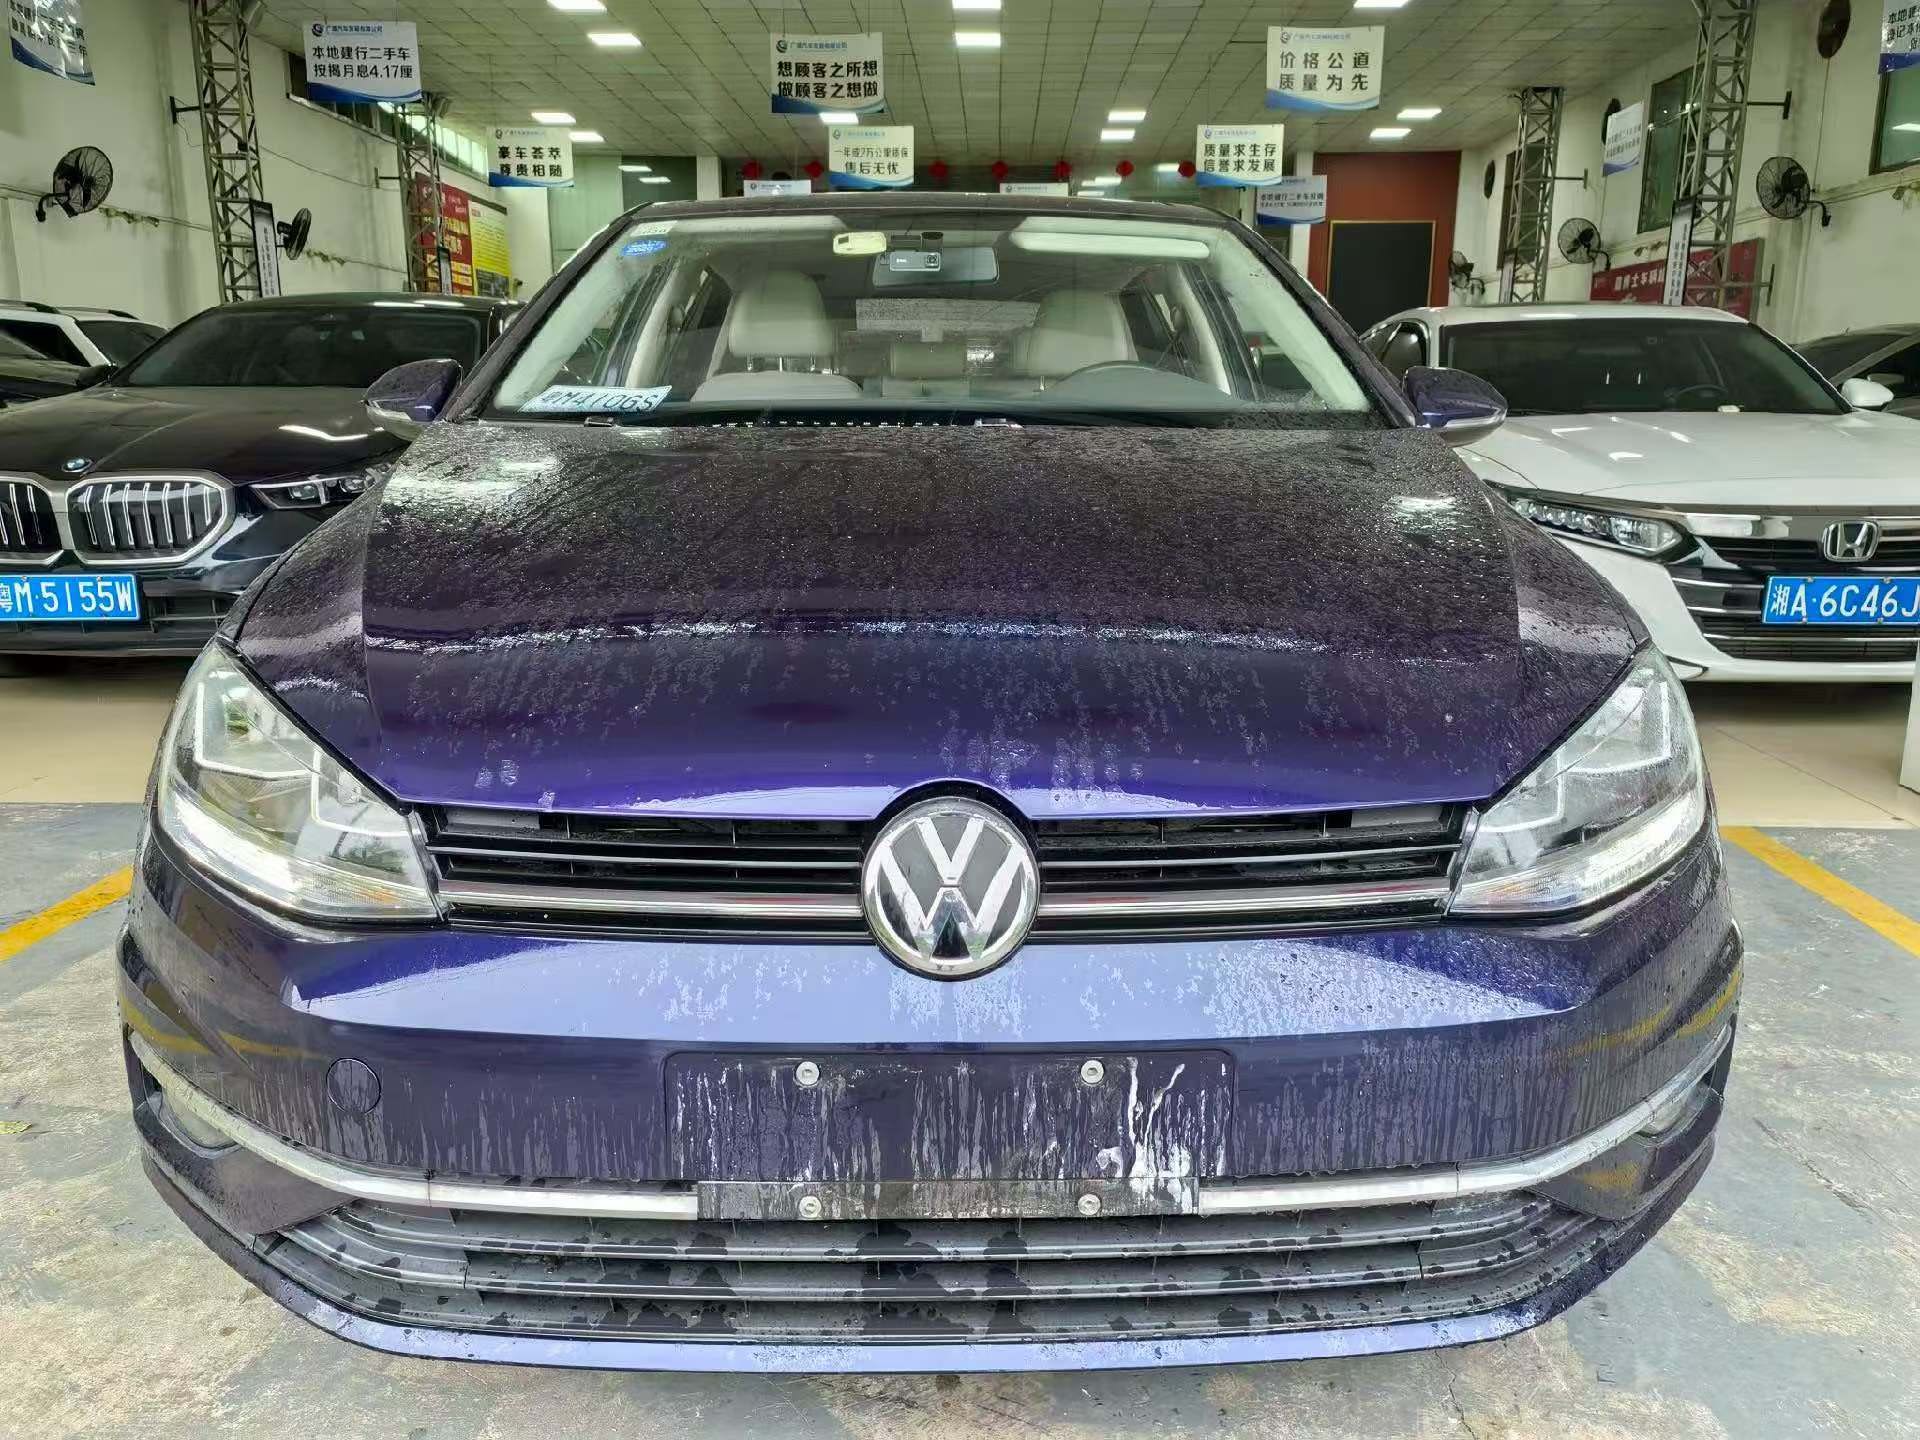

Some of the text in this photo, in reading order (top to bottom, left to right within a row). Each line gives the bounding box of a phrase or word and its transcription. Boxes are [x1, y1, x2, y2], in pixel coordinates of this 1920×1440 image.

[312, 45, 411, 61] 本地建行二手车
[1280, 51, 1370, 69] 价格公道
[314, 63, 413, 78] 按揭月息4.17厘
[777, 60, 878, 78] 想顾客之所想
[777, 81, 879, 98] 做顾客之想做
[1279, 73, 1369, 91] 质量为先
[498, 146, 561, 160] 豪车荟萃
[1204, 143, 1277, 157] 质量求生存
[499, 163, 562, 177] 尊贵相随
[845, 161, 900, 175] 售后无忧
[1203, 159, 1275, 173] 信誉求发展
